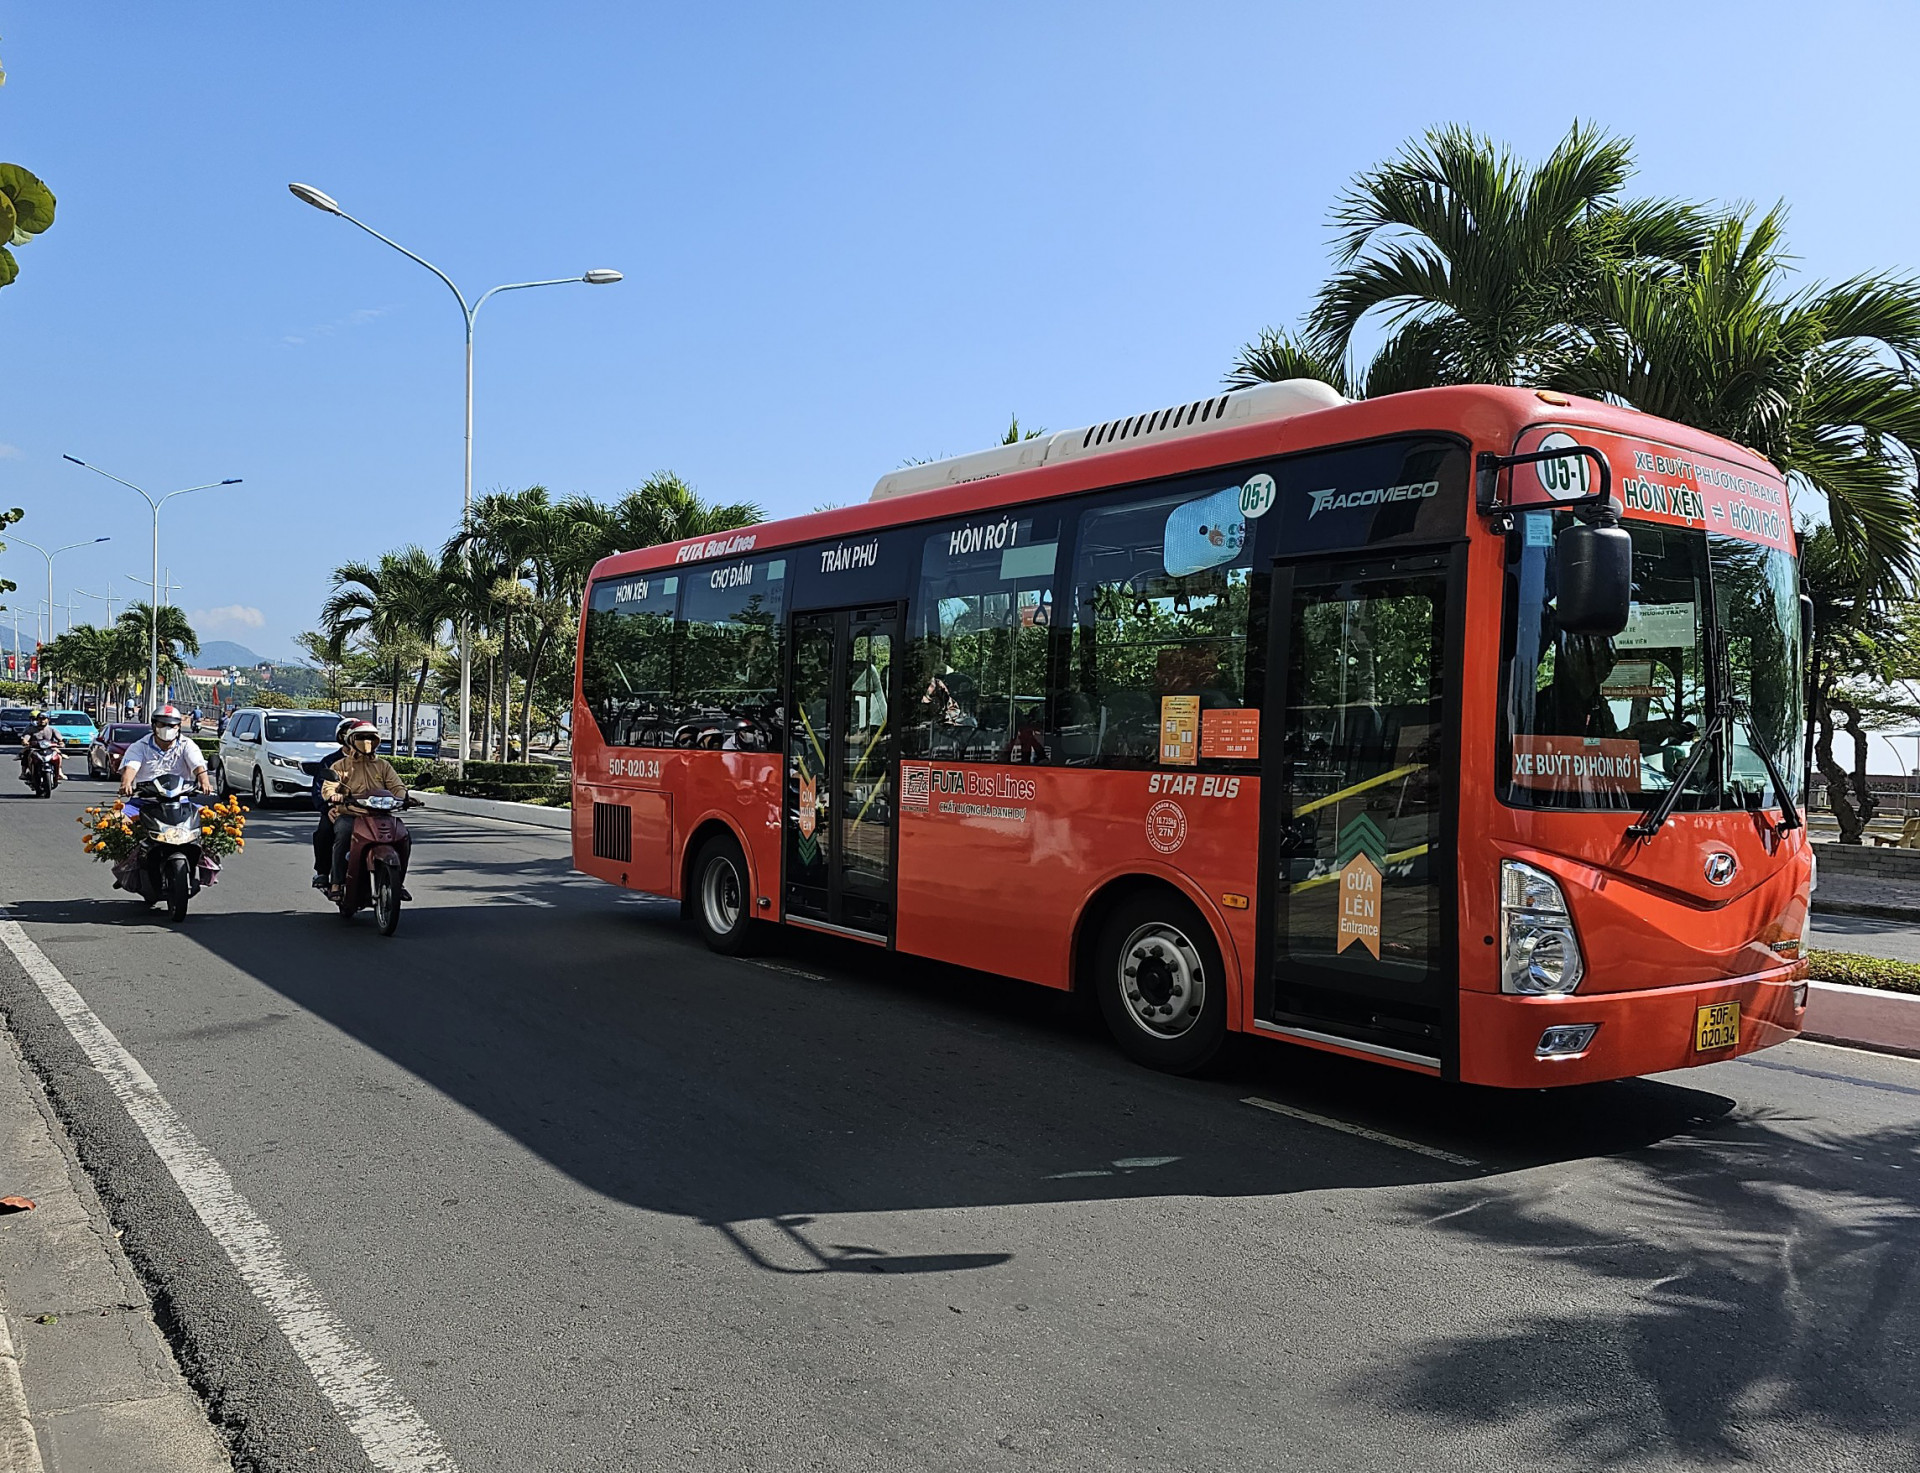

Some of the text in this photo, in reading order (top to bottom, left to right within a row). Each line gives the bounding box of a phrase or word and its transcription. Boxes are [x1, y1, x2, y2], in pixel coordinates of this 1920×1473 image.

[1543, 445, 1586, 491] 05-1
[1634, 450, 1781, 506] XE BUÝT PHƯƠNG TRANG
[1241, 480, 1272, 512] 05-1
[1307, 481, 1440, 521] TRACOMECO
[1623, 475, 1789, 545] HÒN XỆN HÒN RỚ 1
[675, 534, 757, 563] FUTA Bus Lines
[949, 515, 1019, 556] HÒN RỚ 1
[820, 538, 878, 573] TRẦN PHÚ
[615, 581, 632, 603] HÒN
[710, 566, 730, 593] CHỢ
[609, 758, 660, 779] 50F-020.34
[1514, 750, 1639, 779] XE BUÝT ĐI HÒN RỚ 1
[931, 769, 1036, 800] FUTA Bus Lines
[1148, 774, 1240, 798] STAR BUS
[938, 800, 956, 814] CHẤT
[981, 803, 992, 817] LÀ
[991, 806, 1013, 819] DANH
[1158, 828, 1174, 837] 27N
[1346, 867, 1374, 892] CỬA
[1345, 894, 1375, 918] LÊN
[1340, 917, 1379, 937] Entrance
[1709, 1006, 1729, 1027] 50F
[1701, 1025, 1735, 1049] 020.34
